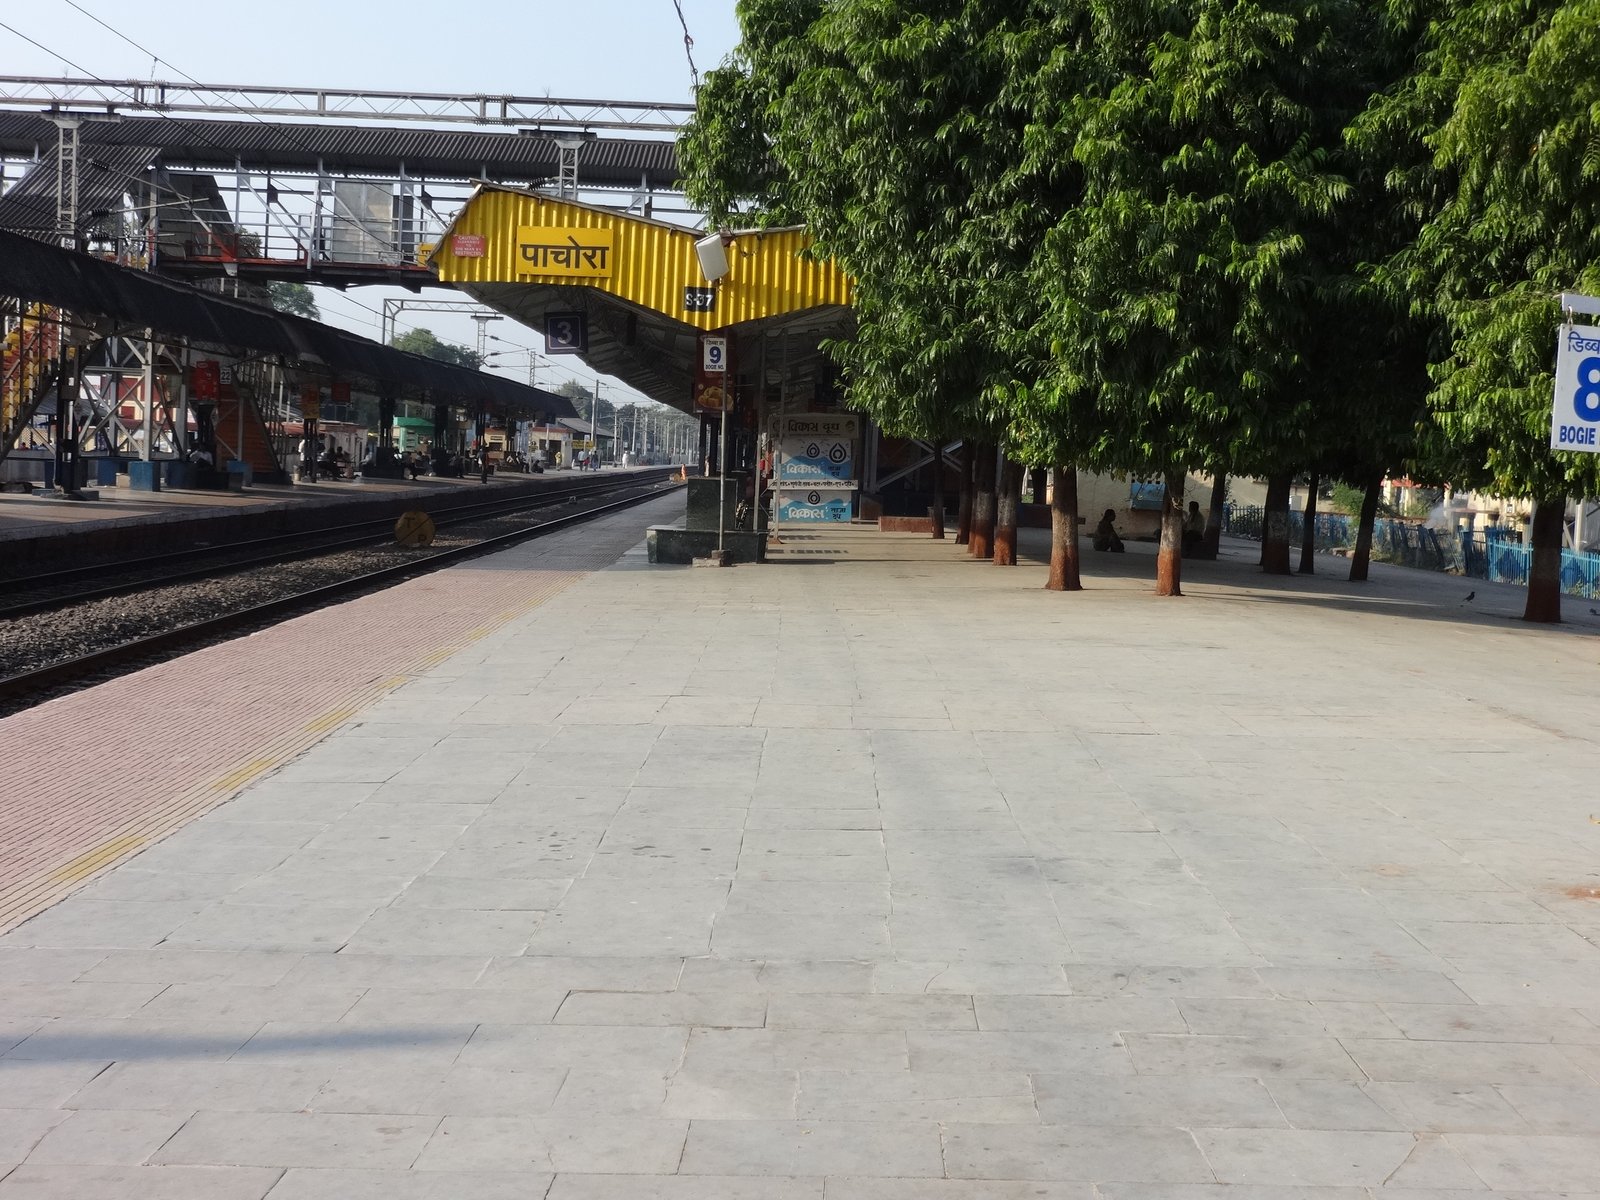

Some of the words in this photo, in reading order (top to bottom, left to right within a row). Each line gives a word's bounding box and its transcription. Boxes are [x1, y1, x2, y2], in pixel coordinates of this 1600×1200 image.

[520, 235, 609, 270] पाचोरा
[557, 320, 573, 345] 3
[709, 346, 722, 364] 9
[221, 371, 231, 380] 22
[788, 419, 818, 432] विकास
[1559, 425, 1596, 446] BOGIE
[786, 463, 822, 474] विकास
[788, 507, 825, 519] विकास
